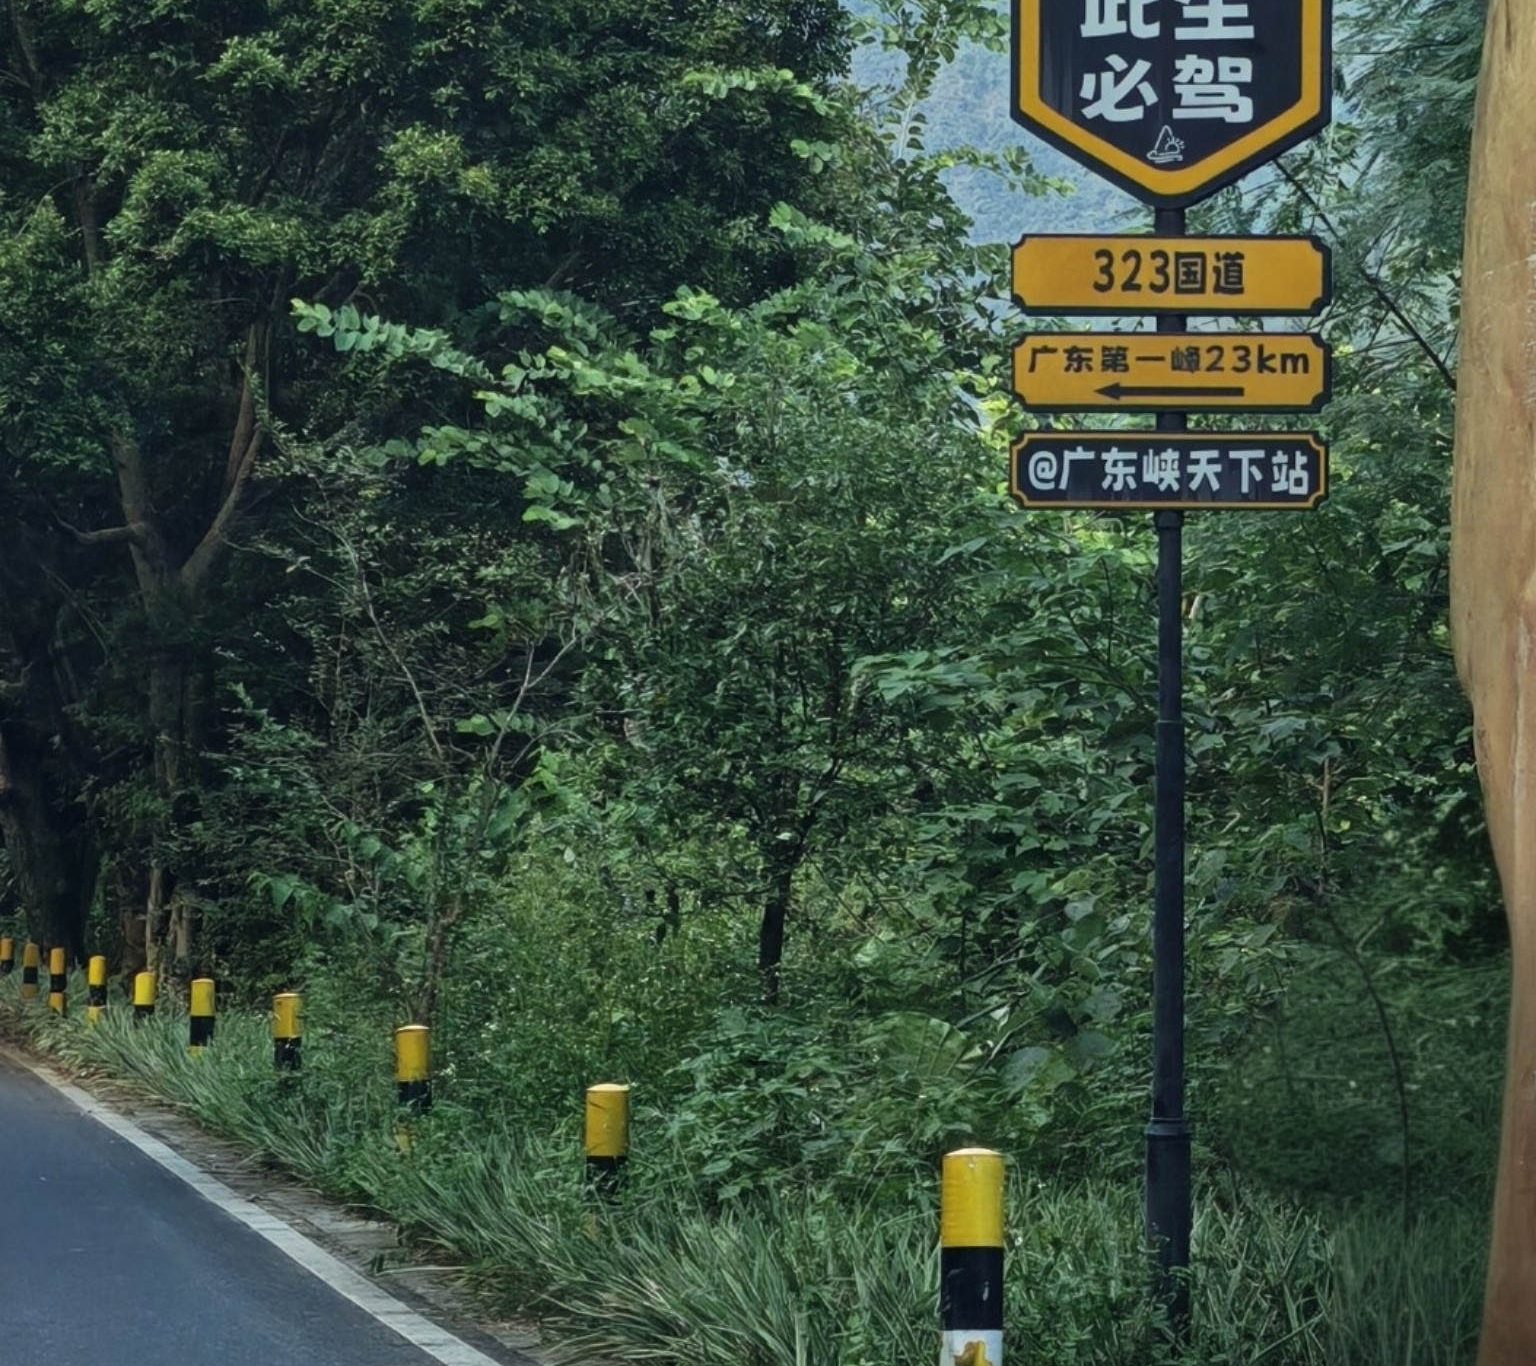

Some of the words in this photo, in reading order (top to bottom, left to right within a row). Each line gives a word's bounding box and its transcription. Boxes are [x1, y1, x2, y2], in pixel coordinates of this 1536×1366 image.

[1078, 53, 1254, 124] 必驾
[1093, 248, 1245, 296] 323国道
[1027, 446, 1311, 496] @广东峡天下站
